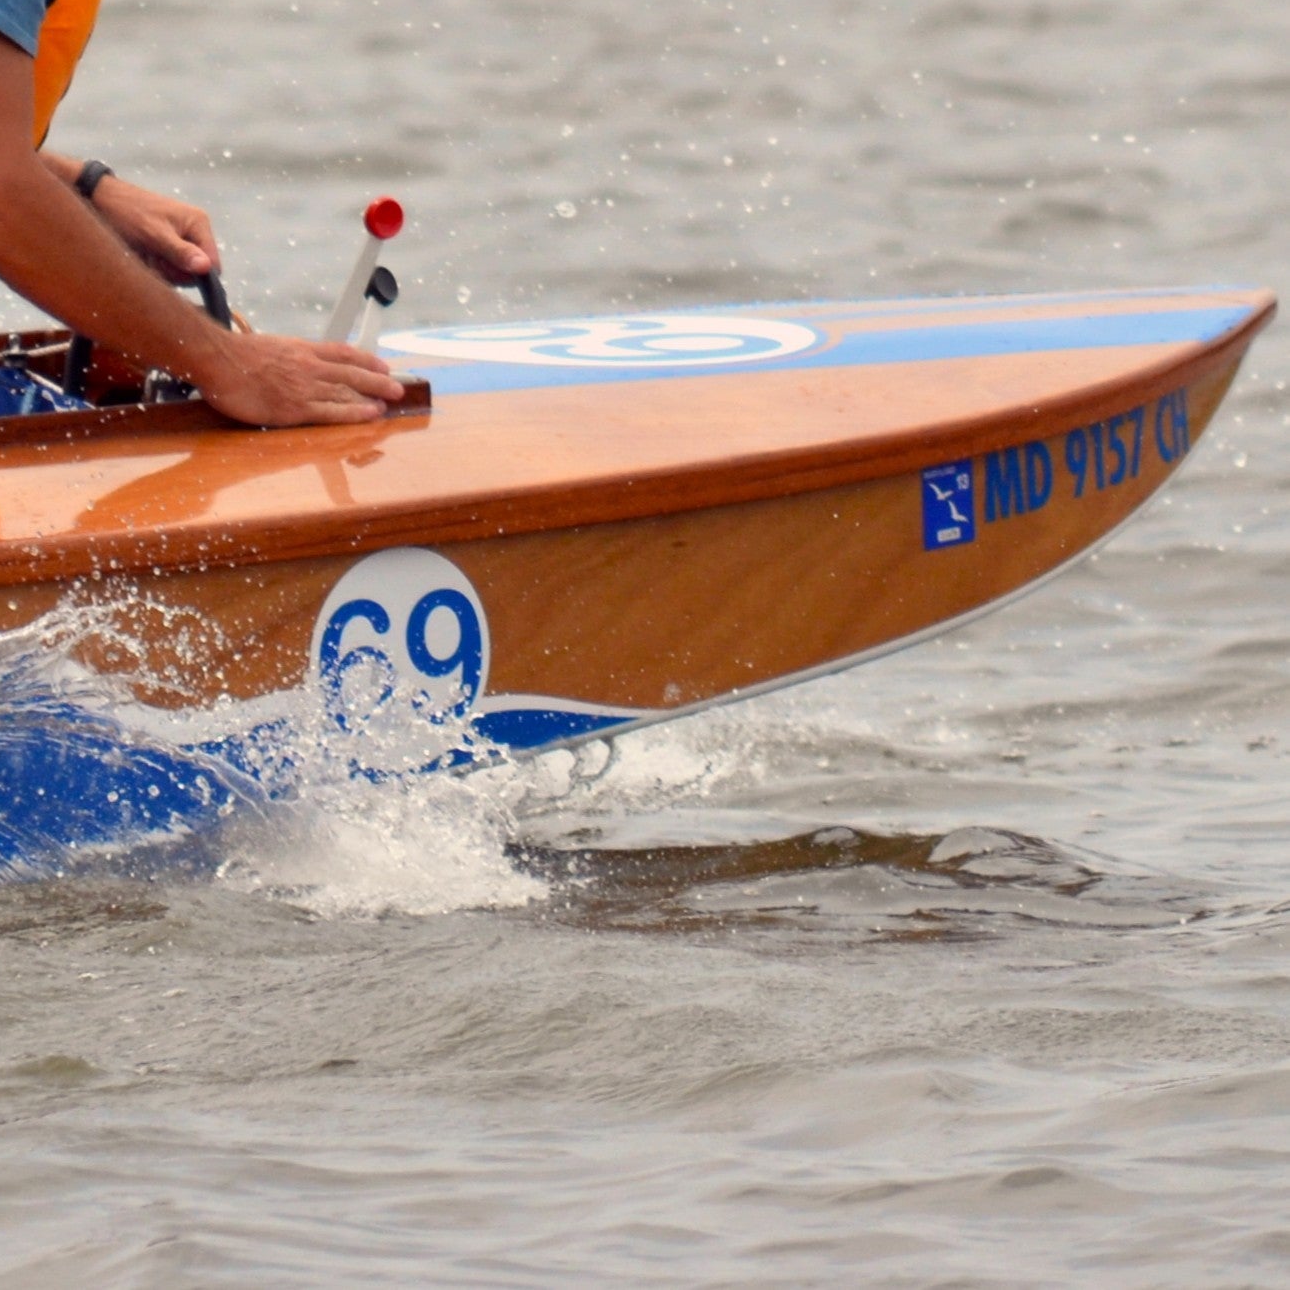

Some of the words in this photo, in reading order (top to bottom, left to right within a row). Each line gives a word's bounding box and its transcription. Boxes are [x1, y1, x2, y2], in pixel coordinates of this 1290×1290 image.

[984, 440, 1053, 523] MD
[1065, 406, 1145, 498] 9157
[1156, 388, 1190, 463] CH
[319, 588, 482, 732] 69
